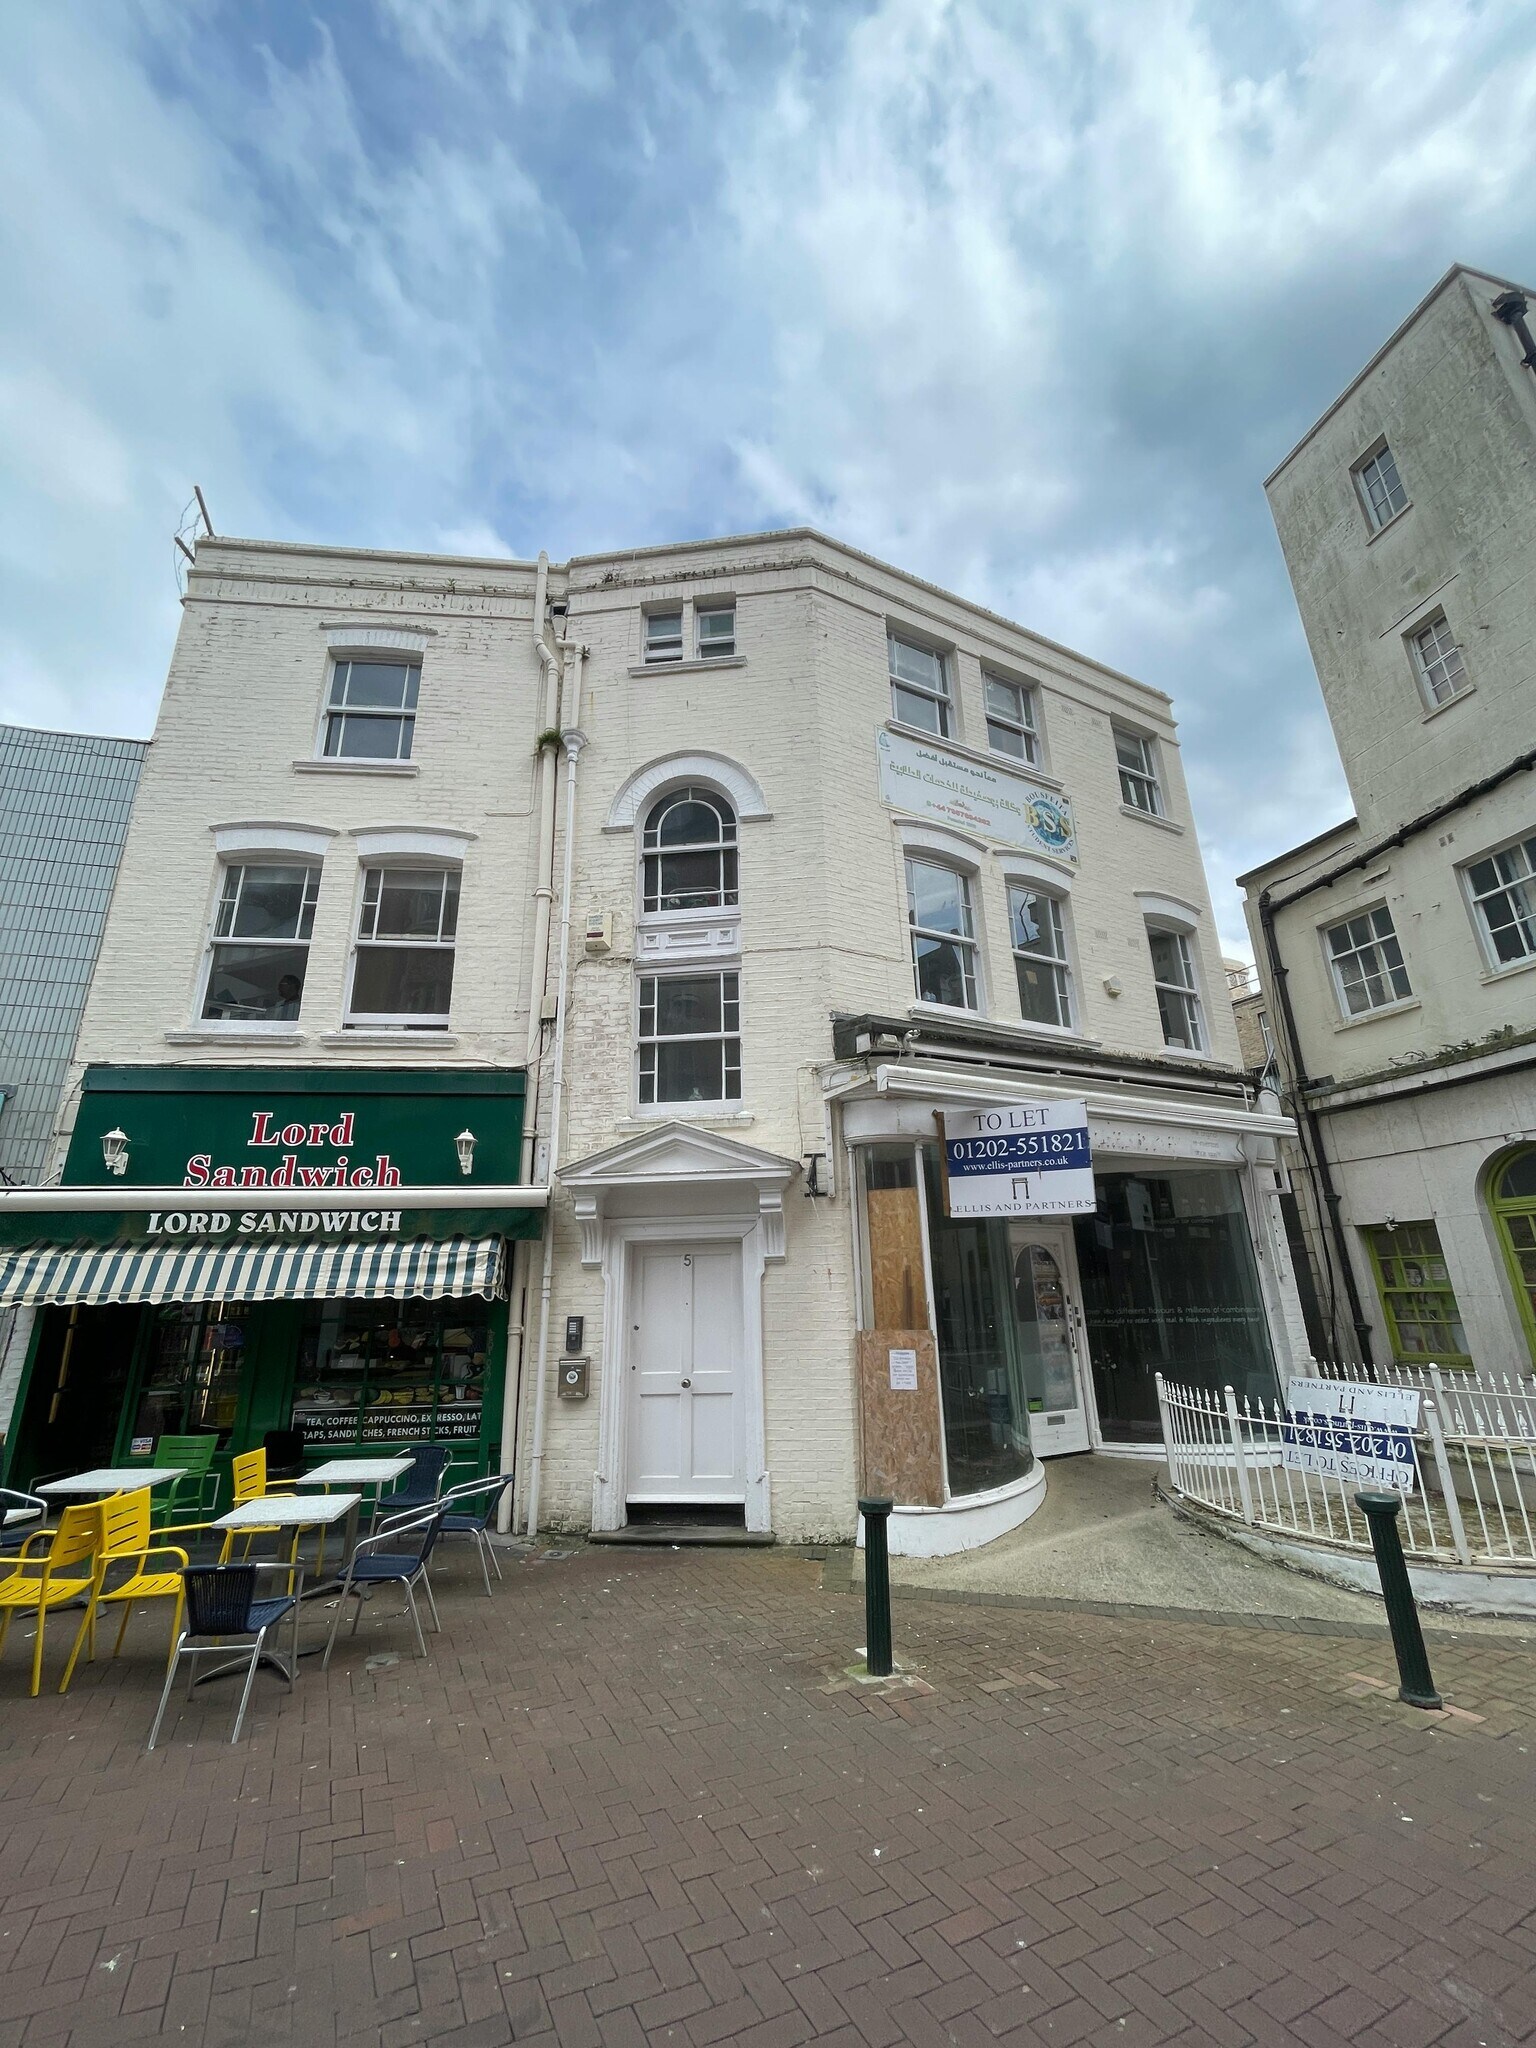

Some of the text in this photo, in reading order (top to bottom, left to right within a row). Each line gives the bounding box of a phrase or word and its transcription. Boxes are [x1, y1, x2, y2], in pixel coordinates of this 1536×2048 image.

[973, 1108, 1050, 1131] TO LET
[247, 1111, 355, 1147] Lord
[953, 1132, 1085, 1160] 01202-551821
[183, 1154, 402, 1187] Sandwich
[963, 1156, 1069, 1172] www.ellis-partners.co.uk
[955, 1200, 1092, 1213] ELLIS AND PARTNERS
[146, 1211, 402, 1234] LORD SANDWICH
[684, 1254, 691, 1266] 5
[1185, 1305, 1211, 1313] millions
[1290, 1380, 1413, 1401] ELLIS AND PARTNERS
[306, 1418, 325, 1427] TEA,
[363, 1414, 420, 1425] CAPPUCCINO,
[421, 1412, 465, 1422] EXRESSO,
[327, 1428, 385, 1438] SANDWCHES,
[387, 1427, 420, 1437] FRENCH
[421, 1426, 452, 1435] STCKS,
[453, 1425, 477, 1434] FRUIT
